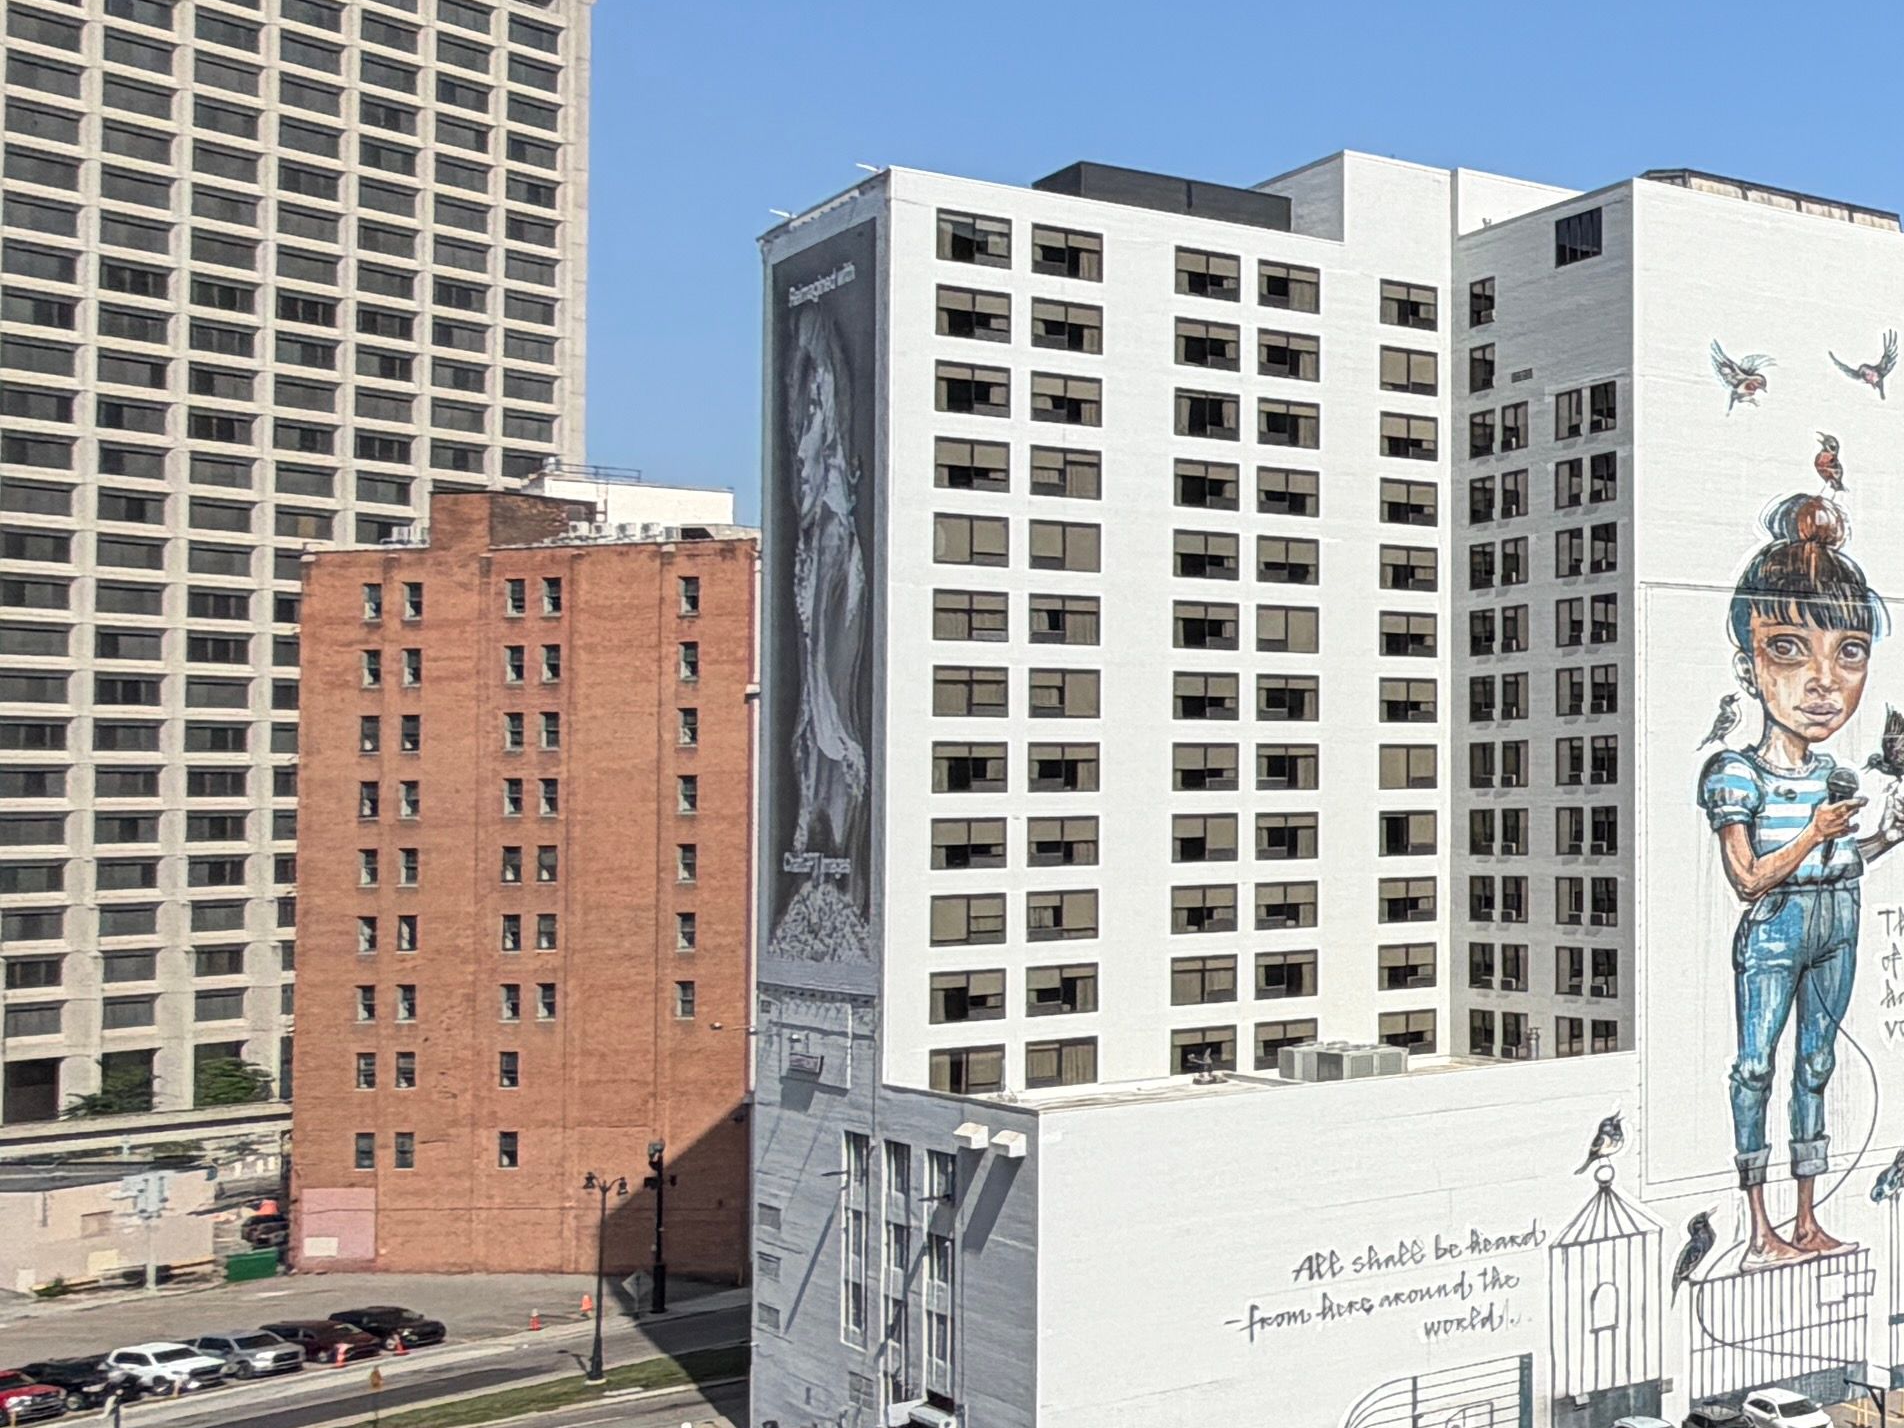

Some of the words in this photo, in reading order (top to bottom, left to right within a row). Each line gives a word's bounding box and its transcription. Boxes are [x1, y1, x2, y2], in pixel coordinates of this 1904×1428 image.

[1881, 942, 1902, 980] of
[1292, 1249, 1344, 1282] All
[1352, 1240, 1425, 1273] shall
[1434, 1234, 1463, 1261] be
[1463, 1218, 1547, 1254] heard
[1316, 1292, 1374, 1321] here
[1378, 1270, 1473, 1308] around
[1477, 1265, 1520, 1293] the
